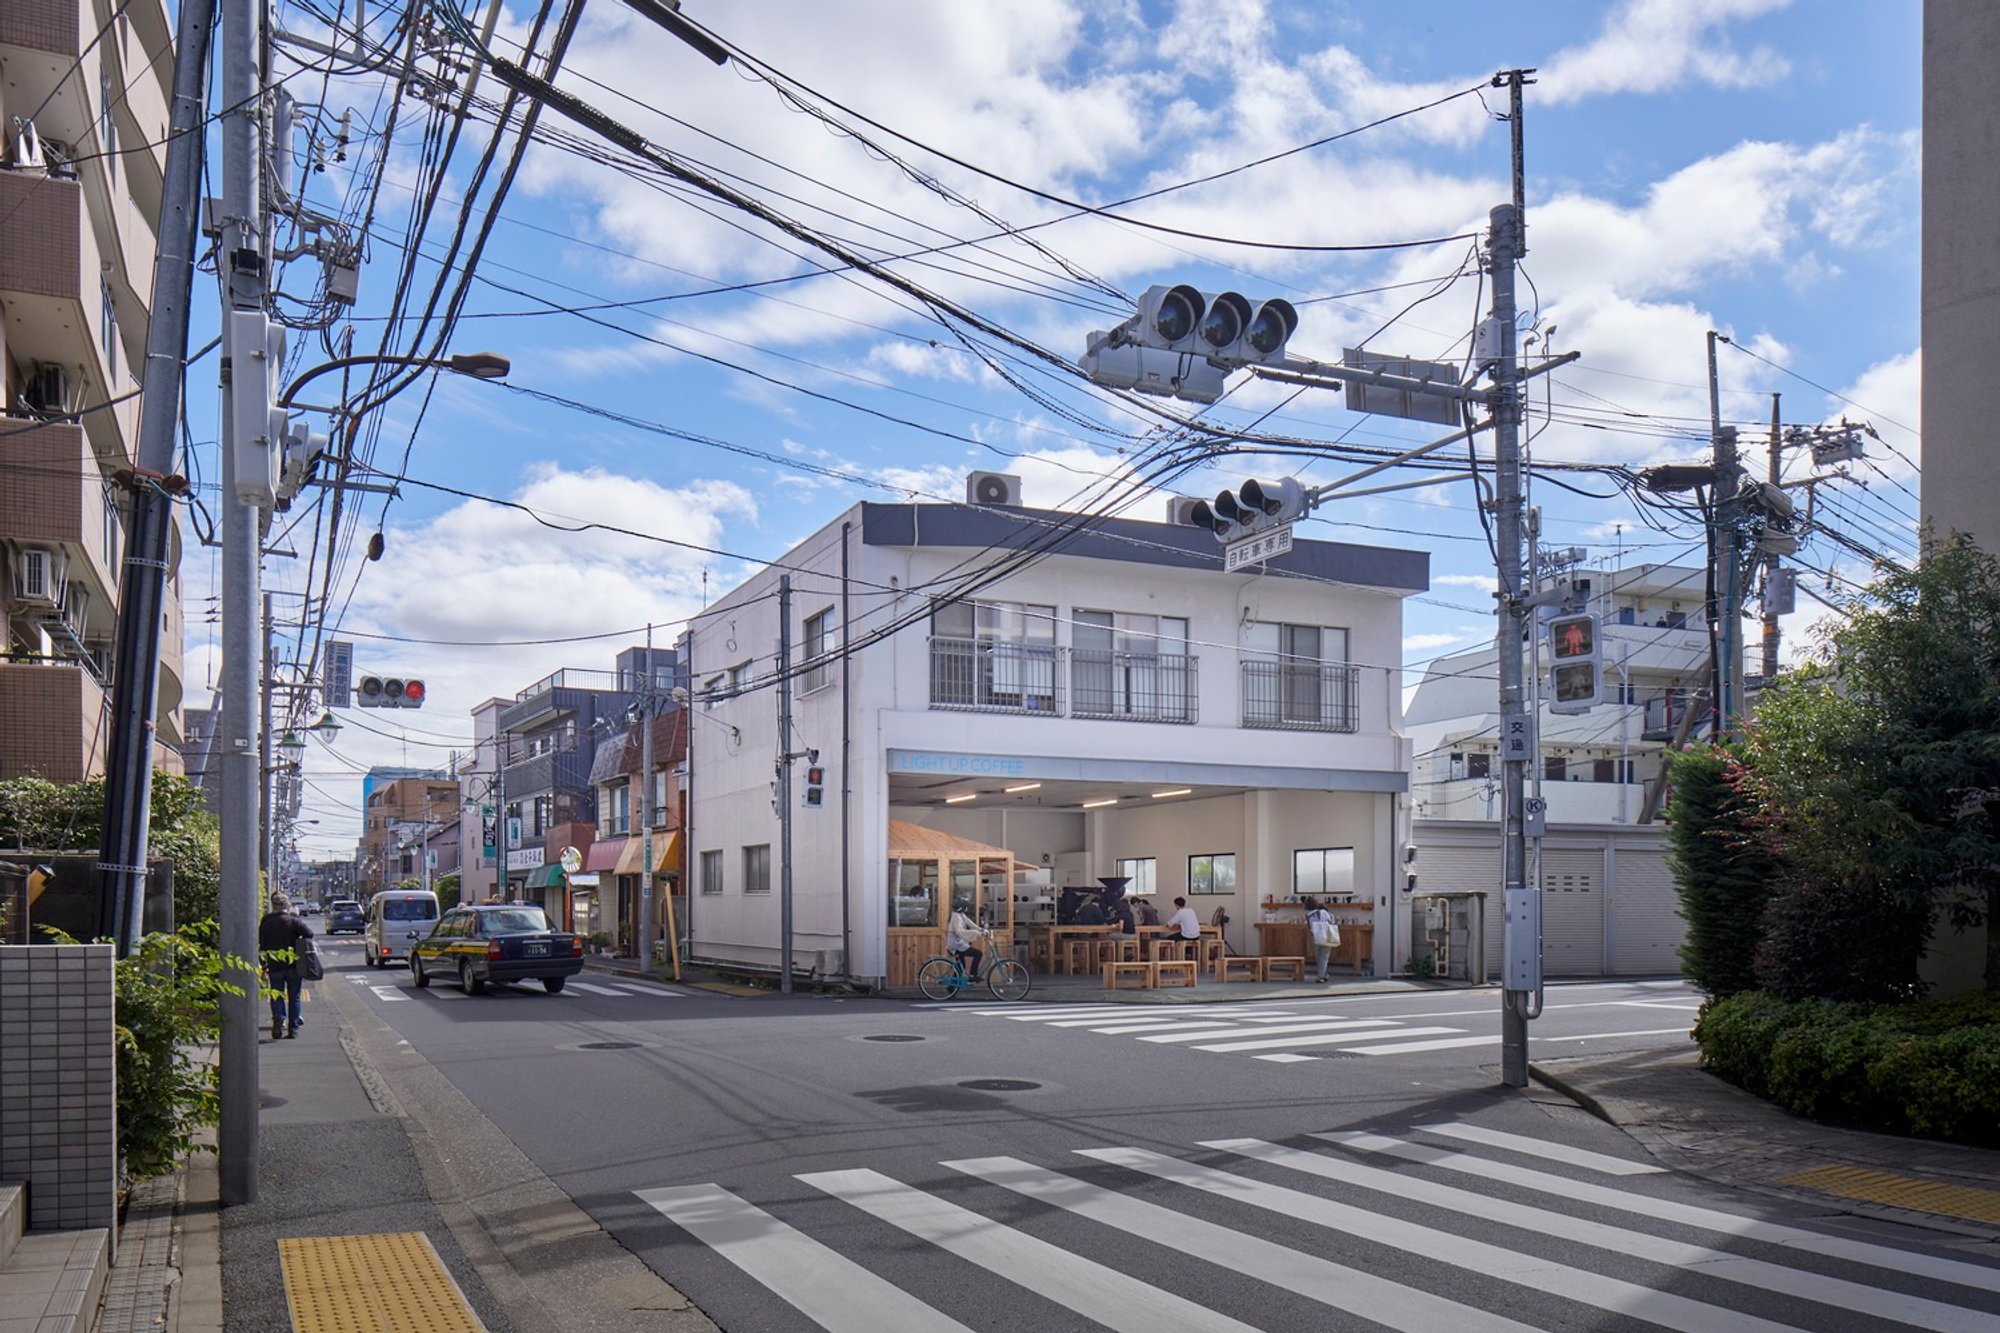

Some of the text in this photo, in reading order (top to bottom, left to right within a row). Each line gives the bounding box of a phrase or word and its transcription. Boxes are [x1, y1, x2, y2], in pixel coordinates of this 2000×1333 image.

[1229, 532, 1288, 567] 自転車専用
[1511, 721, 1524, 751] 交通
[901, 752, 1024, 776] LIGHT UP COFFEE
